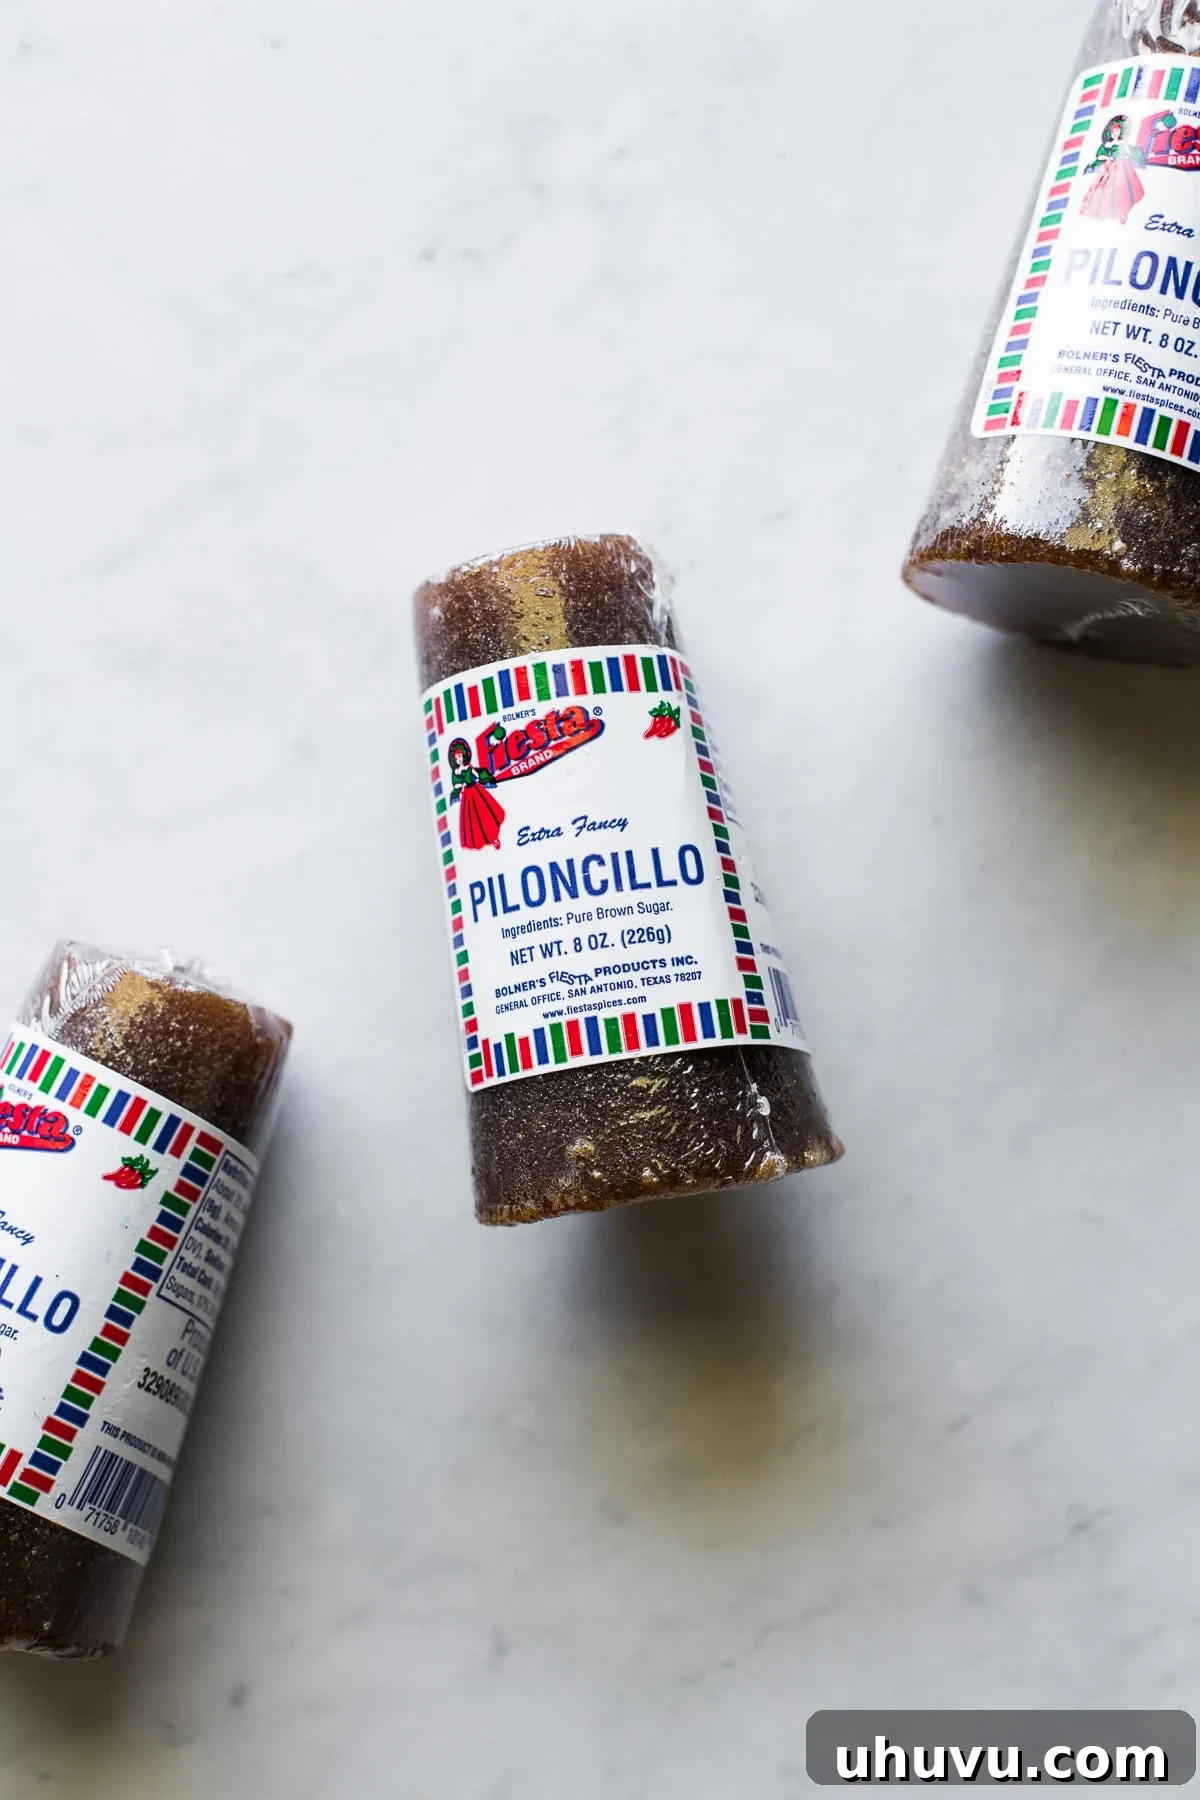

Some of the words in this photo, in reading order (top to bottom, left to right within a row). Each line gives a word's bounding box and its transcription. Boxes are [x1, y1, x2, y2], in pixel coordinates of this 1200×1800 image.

[1144, 213, 1196, 239] Extra
[1090, 295, 1161, 319] Ingredients:
[1089, 320, 1121, 337] NET
[1125, 323, 1153, 345] WT.
[1159, 332, 1170, 349] 8
[1173, 336, 1198, 359] OZ.
[1052, 363, 1093, 376] GENERAL
[1135, 374, 1157, 388] SAN
[1057, 349, 1121, 363] BOLNER'S
[1124, 352, 1167, 379] FIESTA
[502, 708, 537, 723] BOLNER'S
[511, 749, 554, 776] BRAND
[516, 825, 564, 847] Extra
[570, 814, 629, 837] Fancy
[468, 843, 705, 924] PILONCILLO
[501, 915, 564, 940] Ingredients:
[566, 911, 594, 925] Pure
[596, 905, 634, 920] Brown
[637, 900, 674, 917] Sugar.
[509, 946, 535, 967] NET
[539, 940, 568, 960] WT.
[573, 936, 583, 953] 8
[587, 932, 615, 951] OZ.
[620, 924, 672, 949] (226g)
[495, 977, 547, 999] BOLNER'S
[548, 969, 594, 987] FIESTA
[593, 957, 667, 978] PRODUCTS
[670, 954, 699, 970] INC.
[495, 999, 529, 1015] GENERAL
[567, 987, 588, 999] SAN
[639, 974, 672, 988] TEXAS
[673, 970, 703, 984] 78207
[542, 994, 648, 1020] www.fiestaspices.com
[176, 1255, 200, 1281] Total
[166, 1347, 186, 1371] of
[100, 1419, 122, 1439] THIS
[55, 1492, 66, 1510] 0
[84, 1506, 122, 1536] 71758
